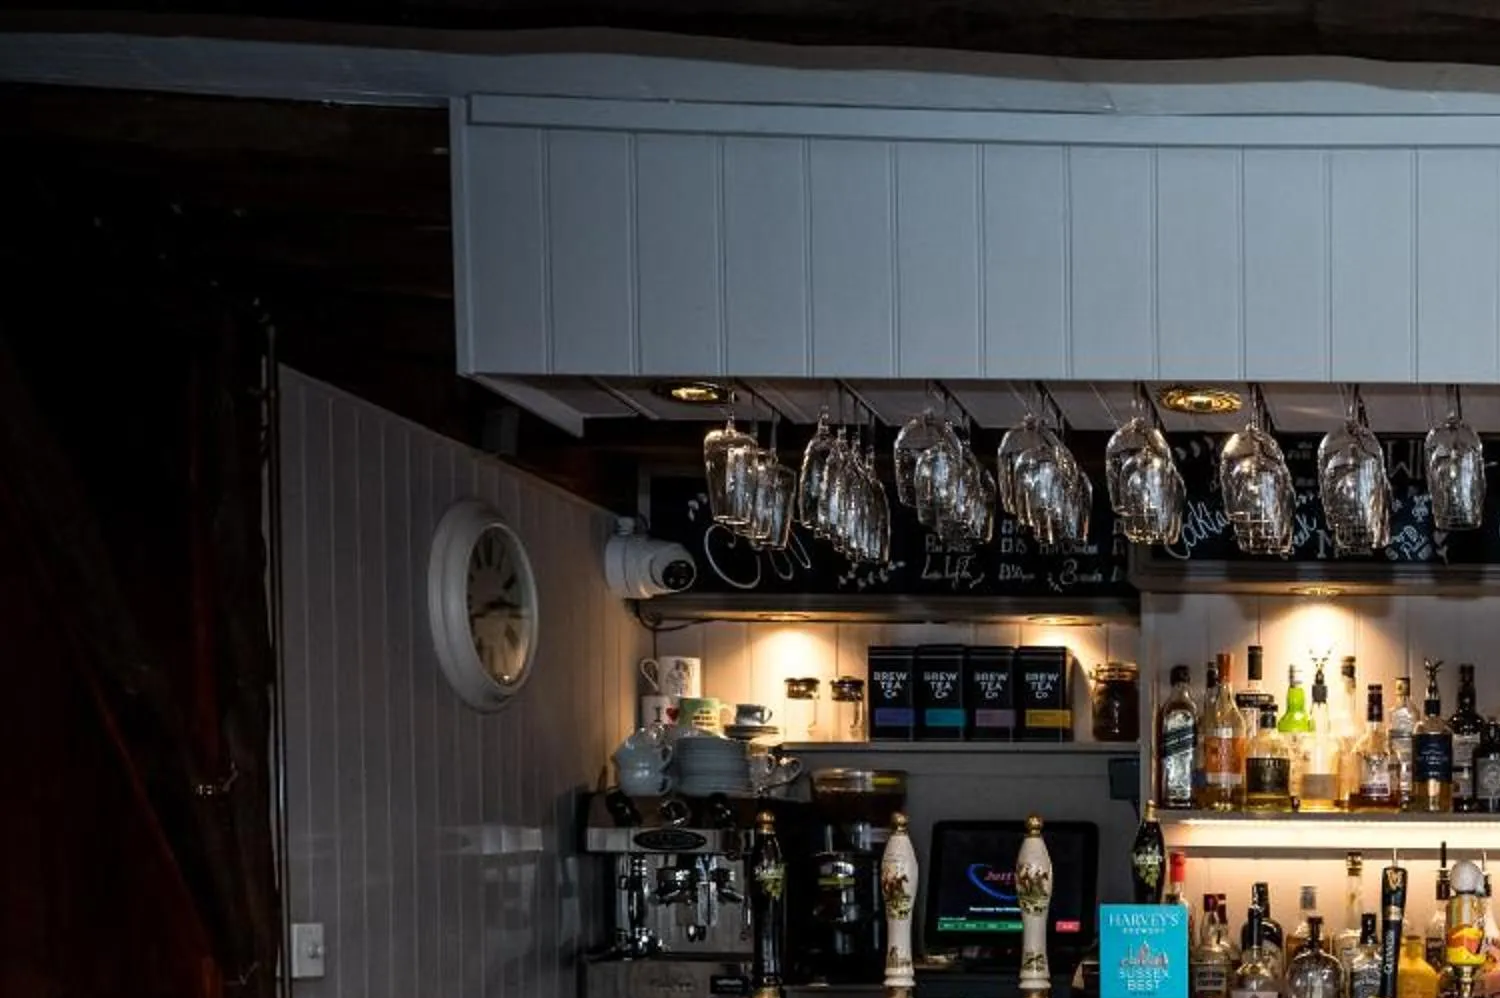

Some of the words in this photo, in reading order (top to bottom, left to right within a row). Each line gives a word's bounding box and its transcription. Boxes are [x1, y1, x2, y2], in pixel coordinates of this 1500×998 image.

[873, 671, 910, 681] BREW
[923, 671, 959, 681] BREW
[974, 671, 1008, 681] BREW
[1025, 672, 1060, 682] BREW
[880, 681, 902, 690] TEA
[930, 681, 952, 690] TEA
[980, 681, 1002, 690] TEA
[1031, 682, 1053, 691] TEA
[1109, 912, 1180, 927] HARVEY'S
[1127, 980, 1161, 990] BEST
